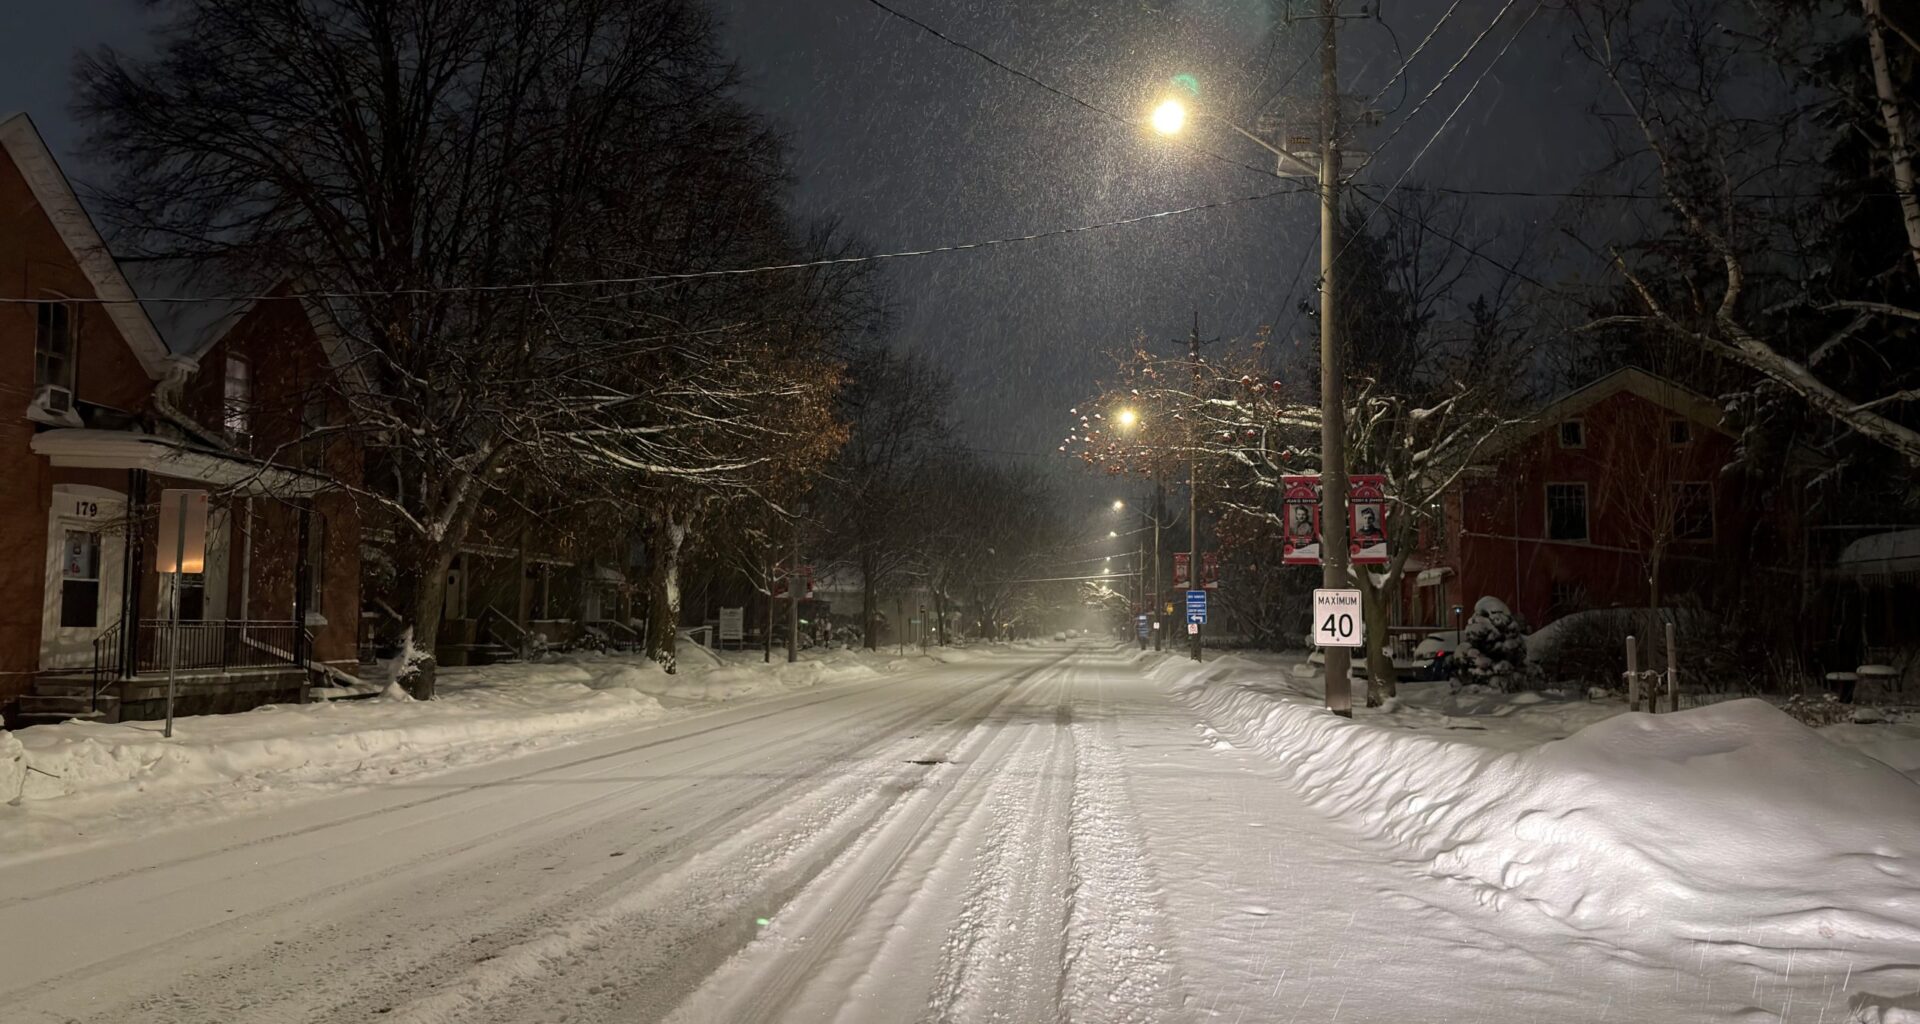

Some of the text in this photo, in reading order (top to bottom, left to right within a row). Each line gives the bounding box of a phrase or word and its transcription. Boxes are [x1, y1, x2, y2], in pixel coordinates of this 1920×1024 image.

[76, 502, 97, 516] 179
[1318, 596, 1357, 605] MAXIMUM
[1321, 613, 1353, 637] 40
